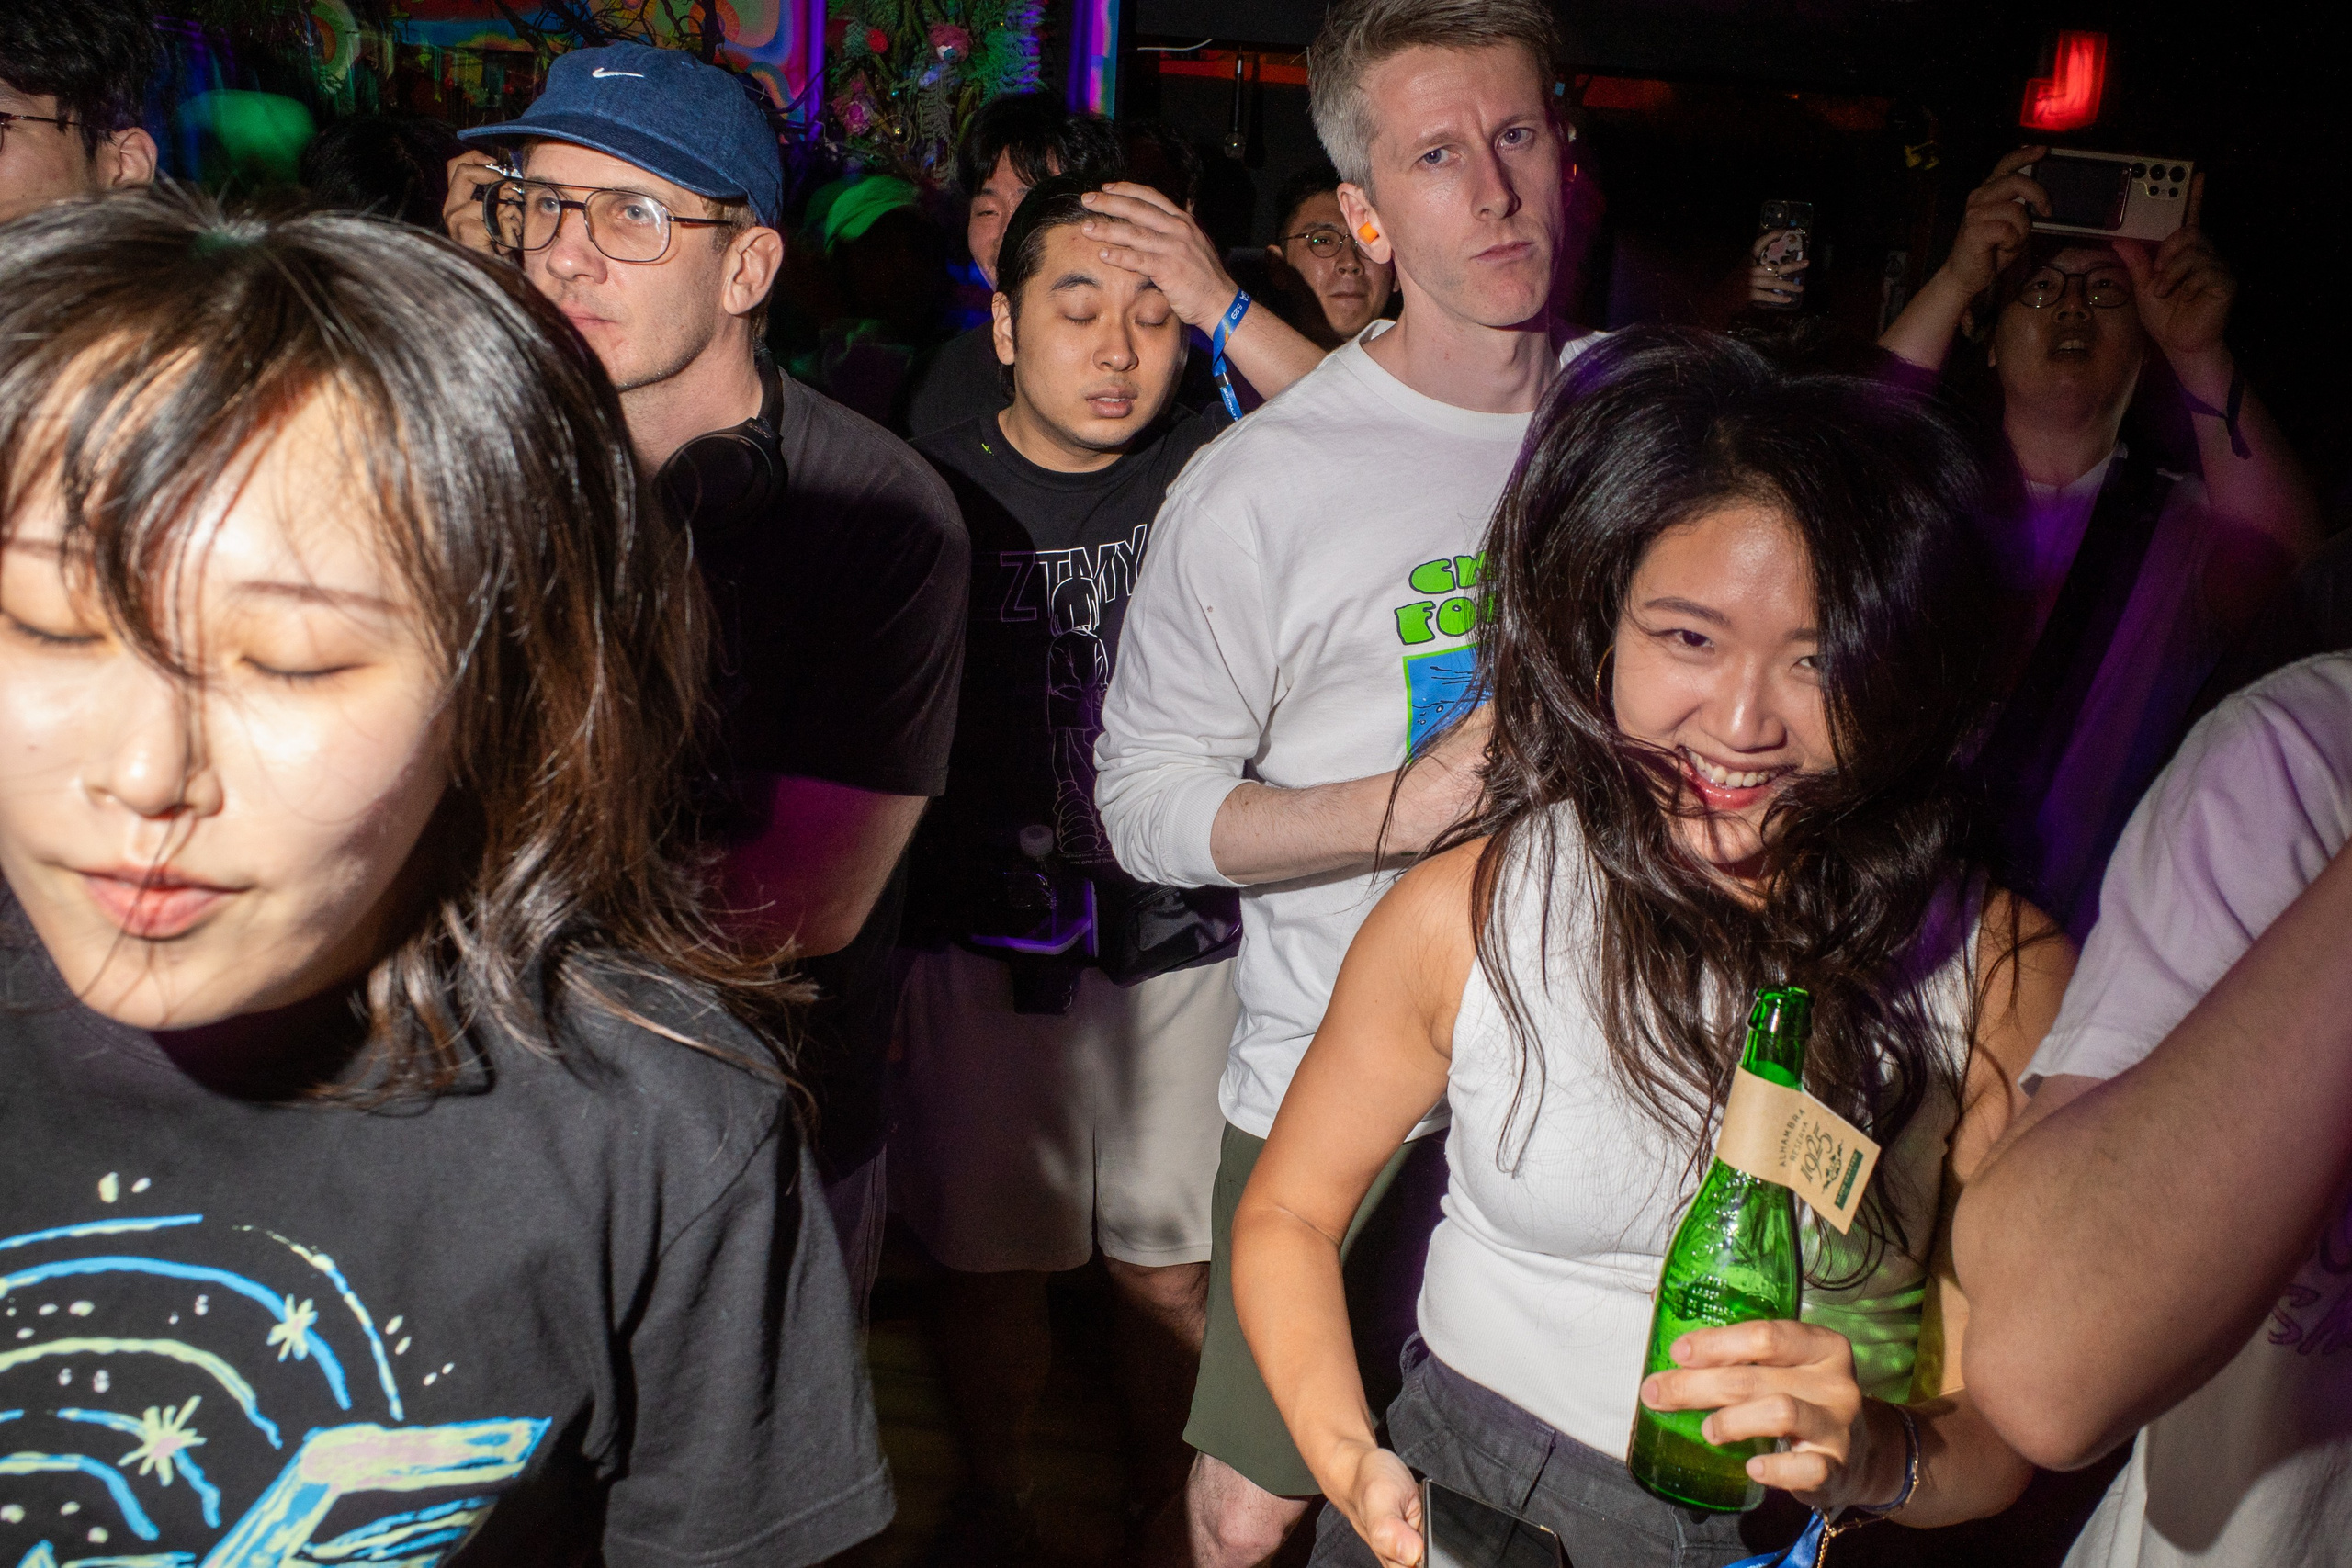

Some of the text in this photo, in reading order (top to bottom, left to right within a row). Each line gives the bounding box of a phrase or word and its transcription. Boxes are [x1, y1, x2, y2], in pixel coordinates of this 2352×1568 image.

[1394, 597, 1497, 646] FO
[1779, 1108, 1805, 1168] ALHAMBRA
[1789, 1121, 1809, 1162] RESERVA
[1800, 1121, 1833, 1185] 1925
